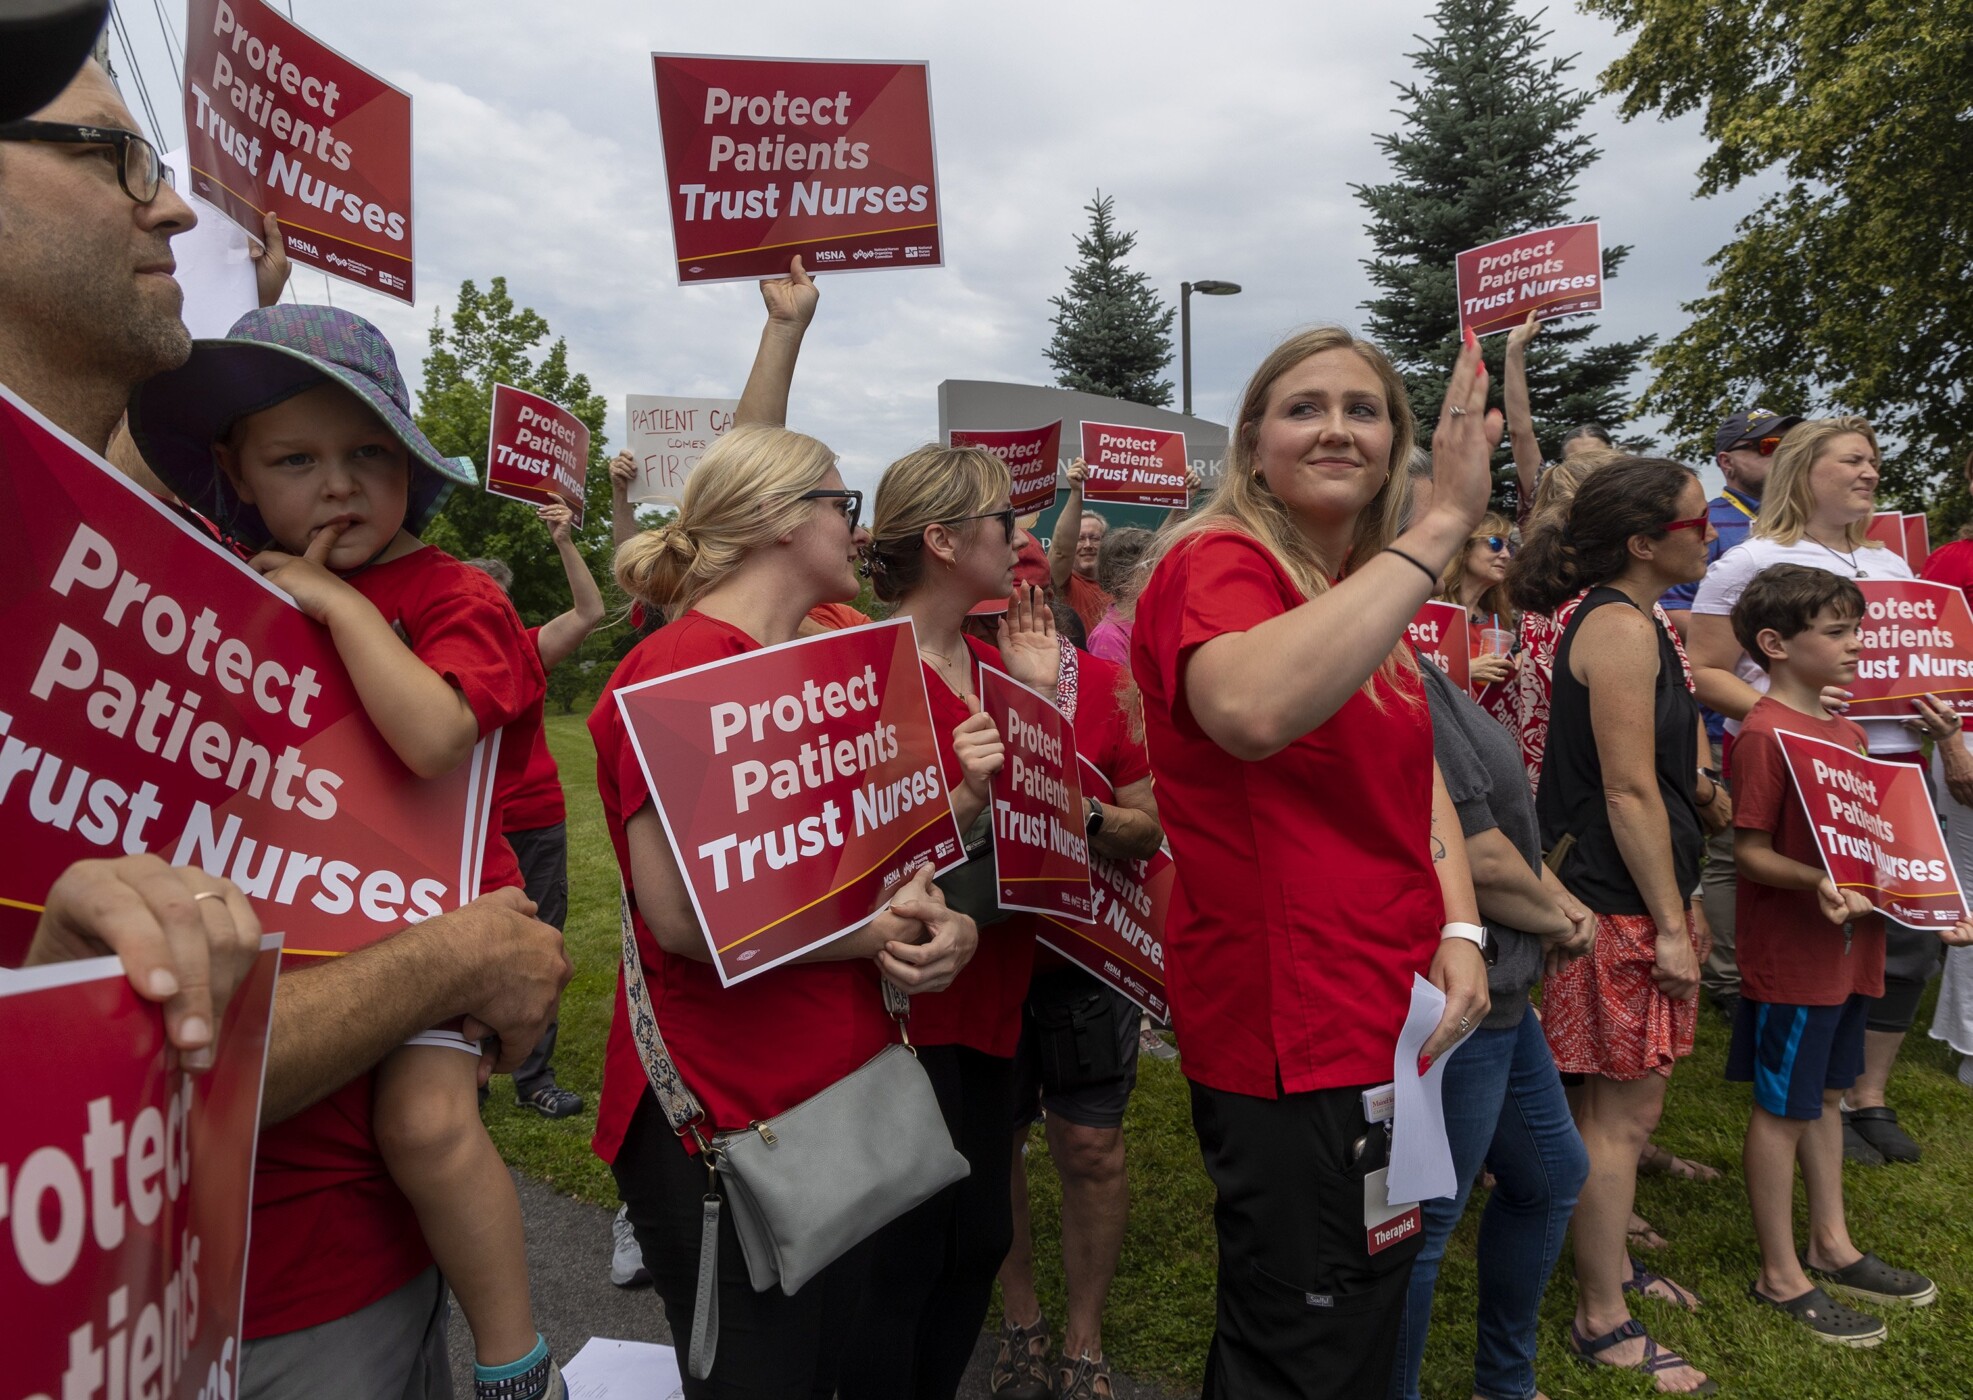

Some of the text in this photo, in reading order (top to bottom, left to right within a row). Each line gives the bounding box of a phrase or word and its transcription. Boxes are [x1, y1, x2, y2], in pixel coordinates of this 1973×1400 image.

[213, 0, 340, 118] Protect
[212, 51, 353, 171] Patients
[703, 87, 852, 126] Protect
[191, 82, 406, 241] Trust Nurses
[708, 134, 870, 172] Patients
[679, 181, 929, 221] Trust Nurses
[288, 235, 319, 256] MSNA
[815, 250, 846, 260] MSNA
[1477, 240, 1555, 274] Protect
[1464, 274, 1597, 315] Trust Nurses
[1478, 259, 1564, 292] Patients
[517, 405, 576, 446] Protect
[632, 408, 699, 431] PATIENT
[515, 427, 577, 470] Patients
[667, 438, 706, 449] COMES
[1099, 433, 1157, 452] Protect
[1100, 449, 1163, 468] Patients
[497, 444, 585, 500] Trust Nurses
[1009, 459, 1043, 477] ients
[1010, 472, 1056, 496] Nurses
[1087, 464, 1129, 481] Trust
[1131, 469, 1185, 487] Nurses
[49, 522, 322, 728] Protect
[1866, 597, 1937, 620] otect
[1857, 655, 1900, 679] ust
[29, 623, 344, 820] Patients
[710, 664, 879, 755] Protect
[1007, 707, 1062, 769] Protect
[732, 720, 899, 814] Patients
[1011, 755, 1070, 814] Patients
[1812, 758, 1878, 807] Protect
[698, 765, 940, 893] Trust Nurses
[996, 799, 1086, 866] Trust Nurses
[1826, 792, 1895, 843] Patients
[170, 801, 448, 924] Nurses
[1820, 825, 1947, 882] Trust Nurses
[883, 868, 901, 887] MSNA
[1104, 960, 1121, 978] MSNA
[1374, 1217, 1415, 1246] Therapist
